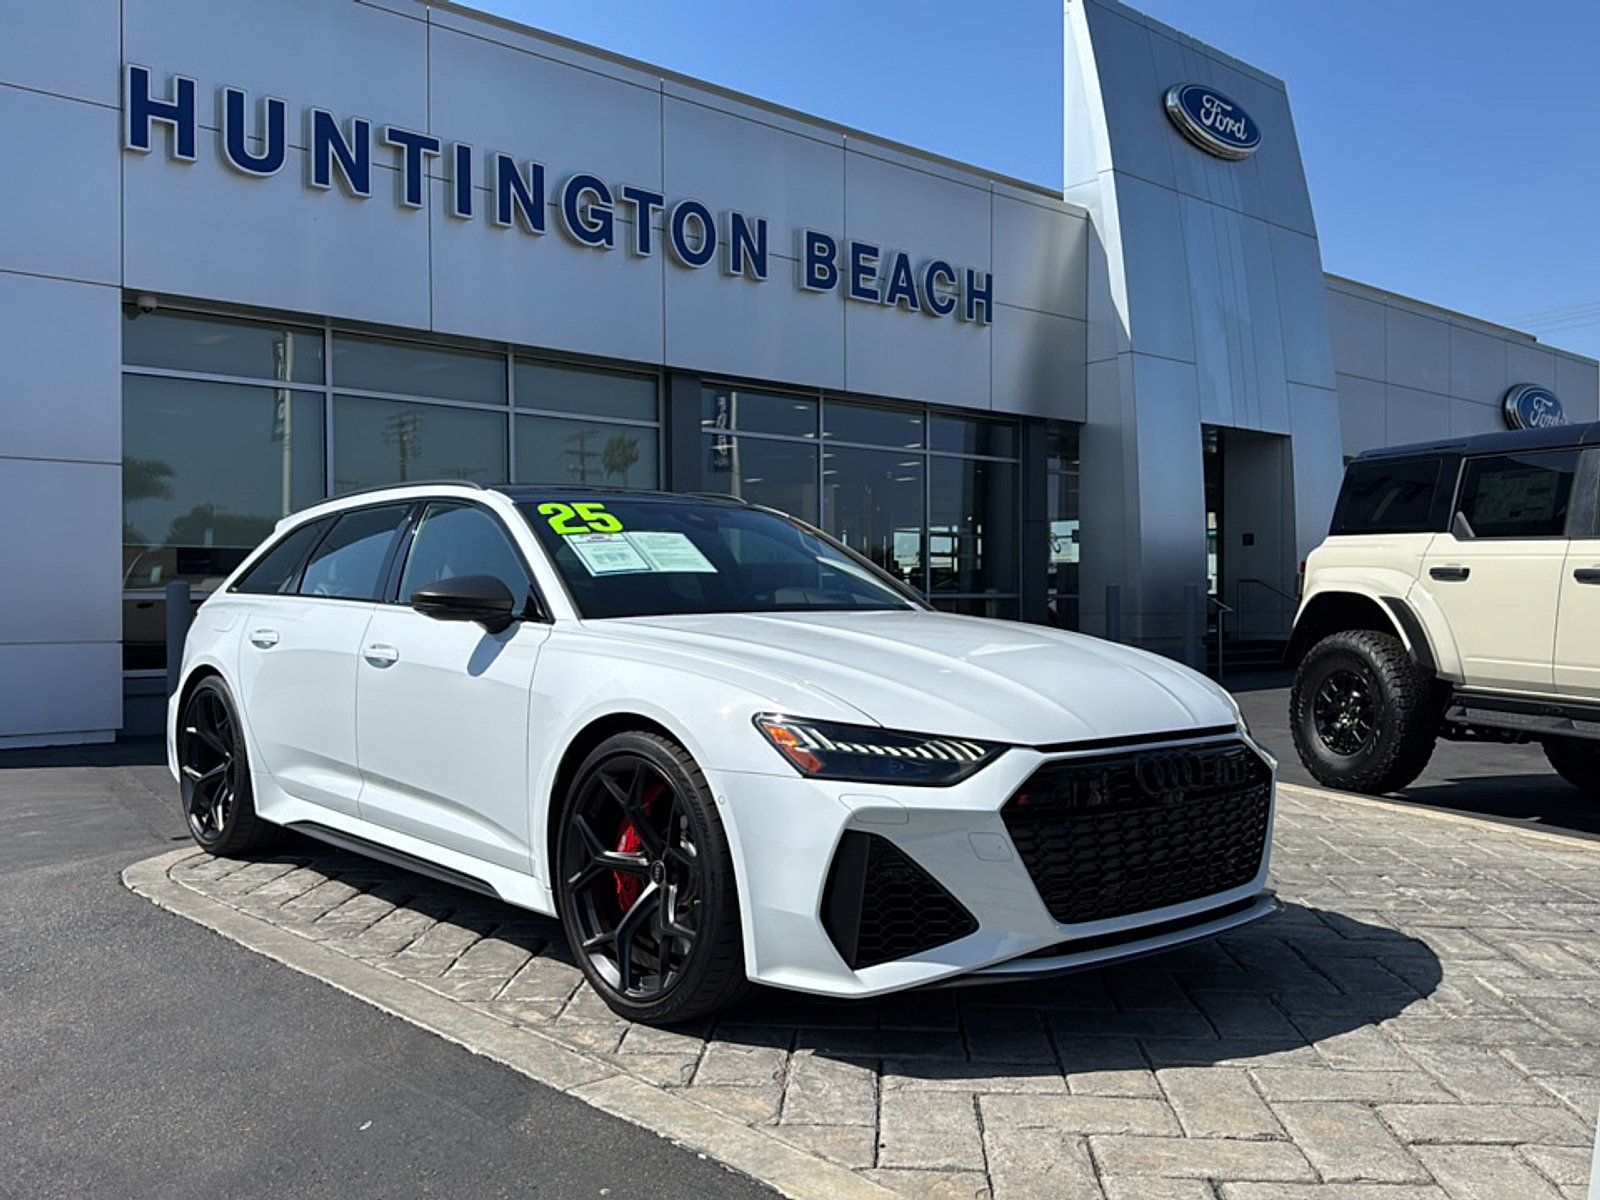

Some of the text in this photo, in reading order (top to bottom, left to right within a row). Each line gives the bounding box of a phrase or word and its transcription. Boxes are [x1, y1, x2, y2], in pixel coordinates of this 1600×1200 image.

[1200, 94, 1248, 140] Ford
[124, 63, 994, 325] HUNTINGTON BEACH
[536, 502, 624, 535] 25
